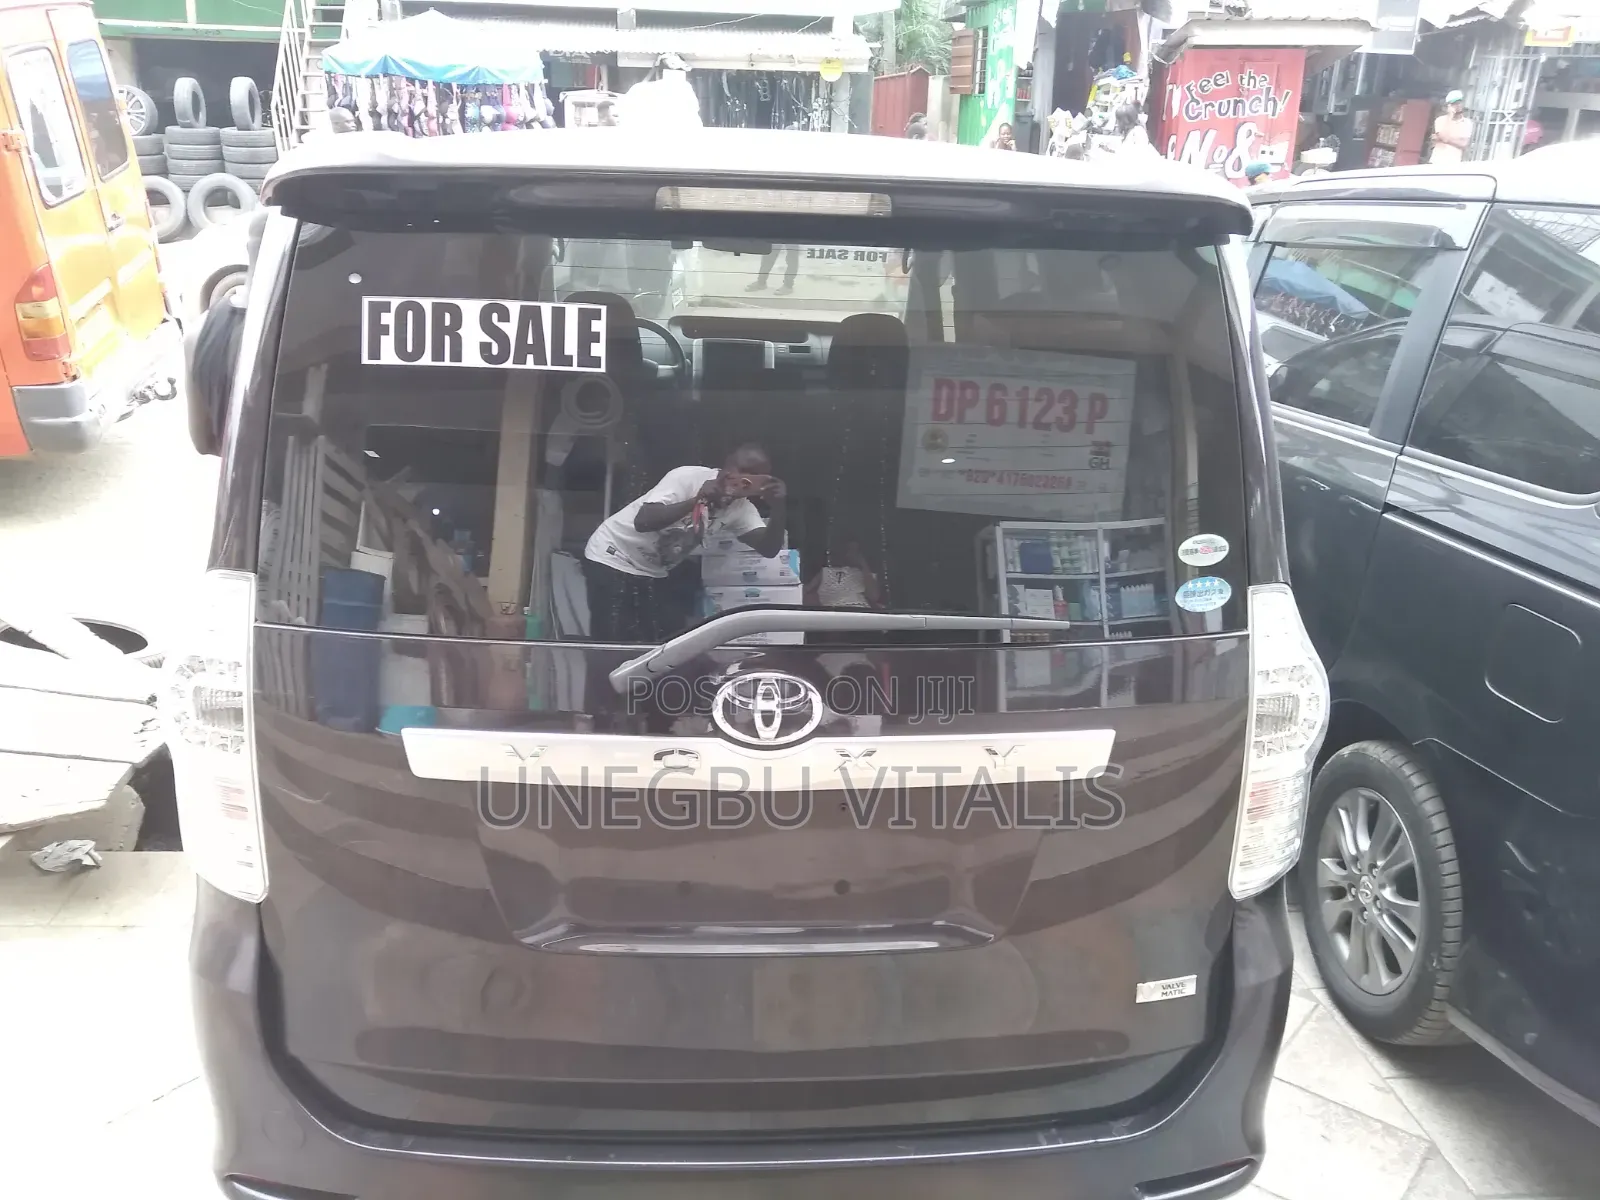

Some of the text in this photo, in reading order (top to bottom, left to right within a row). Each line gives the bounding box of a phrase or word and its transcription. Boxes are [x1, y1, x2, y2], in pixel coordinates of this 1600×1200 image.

[1184, 86, 1292, 122] Crunch!
[1185, 71, 1231, 103] Feel
[1239, 71, 1268, 89] the
[367, 300, 602, 369] FOR SALE
[932, 378, 1109, 435] DP 6123 P
[1161, 981, 1187, 990] VALVE
[1161, 989, 1187, 997] MATIC
